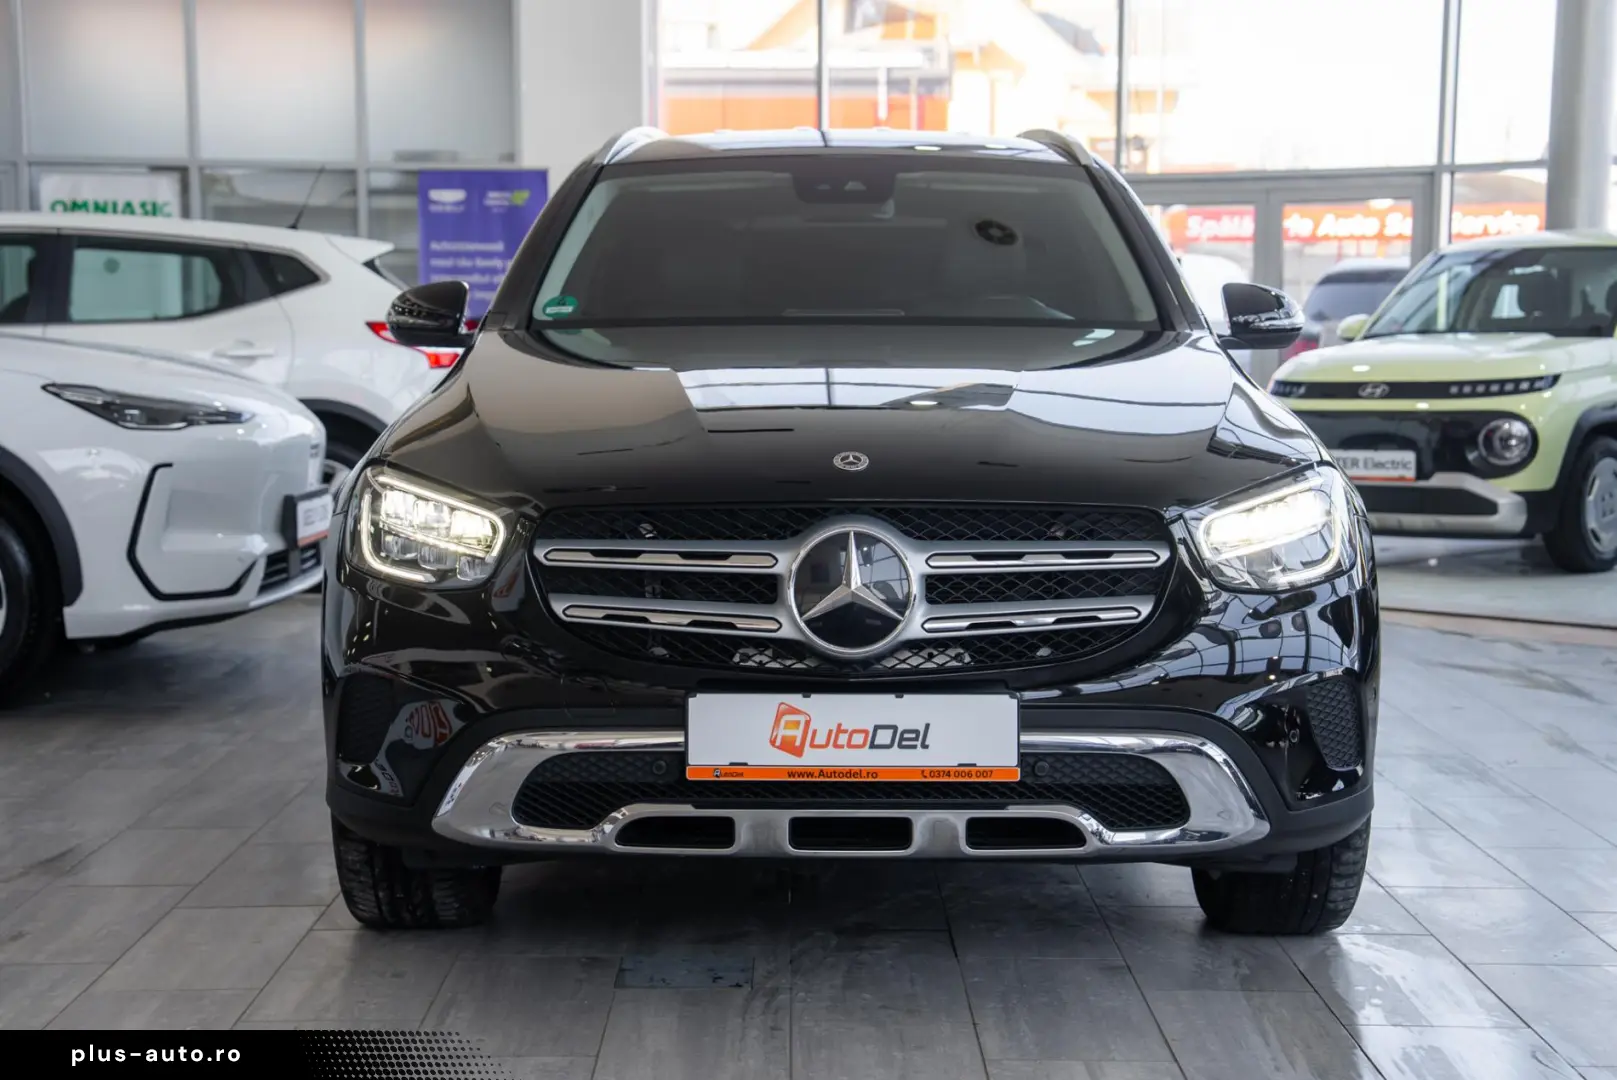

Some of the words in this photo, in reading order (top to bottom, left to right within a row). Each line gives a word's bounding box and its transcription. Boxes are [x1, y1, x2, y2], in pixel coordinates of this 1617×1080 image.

[1316, 213, 1380, 237] Auto
[1363, 456, 1412, 471] Electric
[771, 706, 931, 756] AutoDel
[787, 769, 878, 779] www.Autodel.ro
[929, 769, 951, 779] 0374
[953, 769, 973, 779] 006
[975, 769, 994, 779] 007
